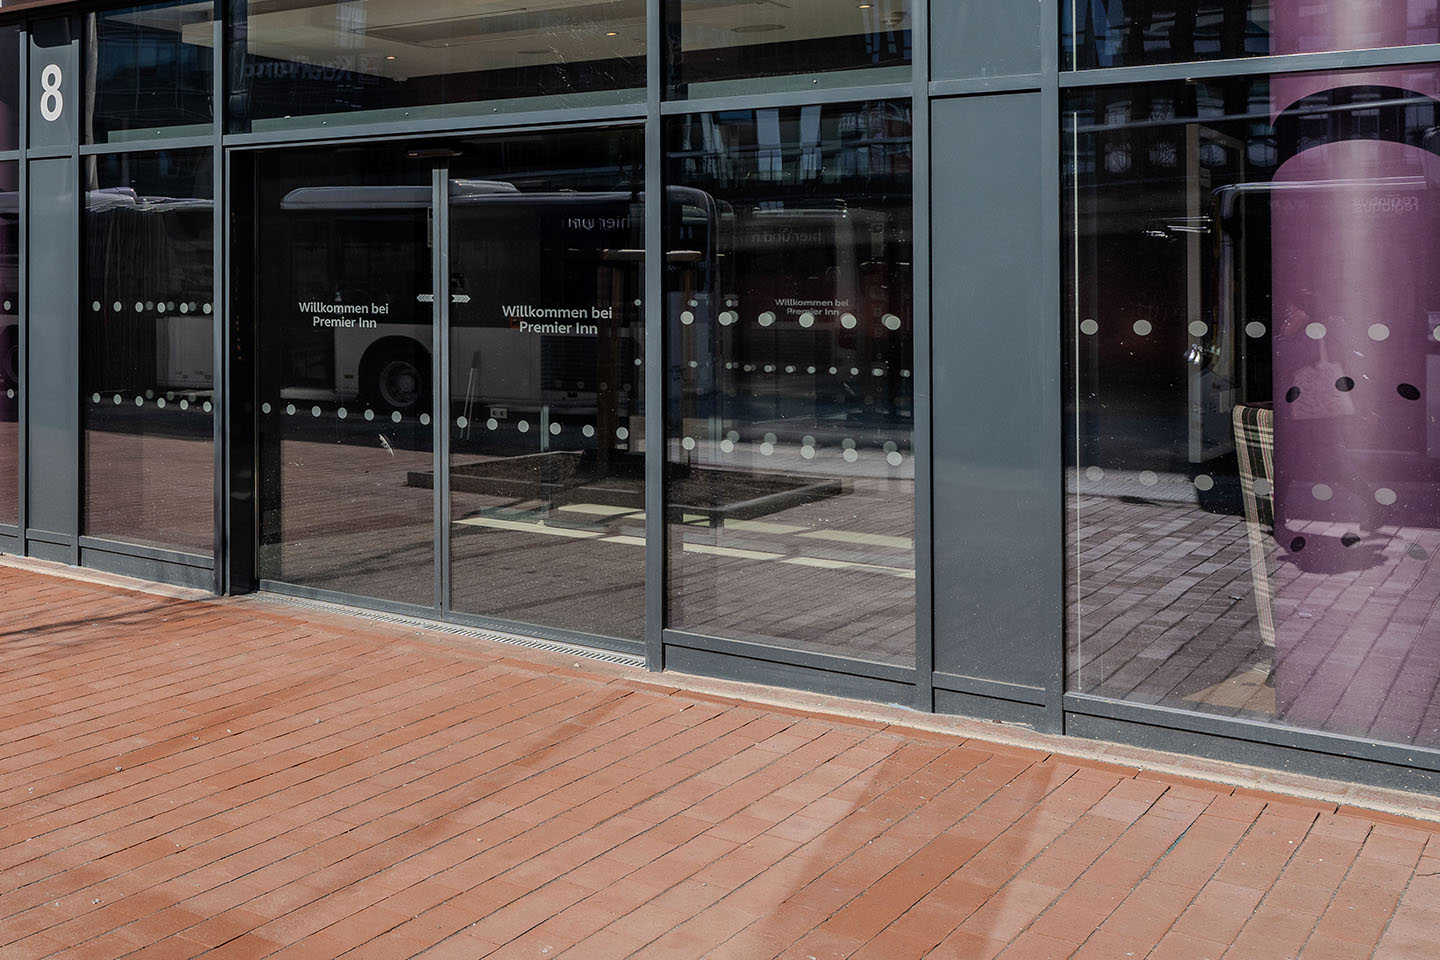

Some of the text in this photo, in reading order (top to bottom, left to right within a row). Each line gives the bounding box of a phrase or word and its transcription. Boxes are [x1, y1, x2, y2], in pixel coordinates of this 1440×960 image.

[40, 63, 64, 122] 8
[298, 301, 389, 315] Willkommen bei
[774, 298, 849, 307] Willkommen bei
[501, 305, 613, 319] Willkommen bei
[786, 307, 840, 316] Premier Inn
[312, 315, 377, 329] Premier Inn
[519, 321, 598, 335] Premier Inn
